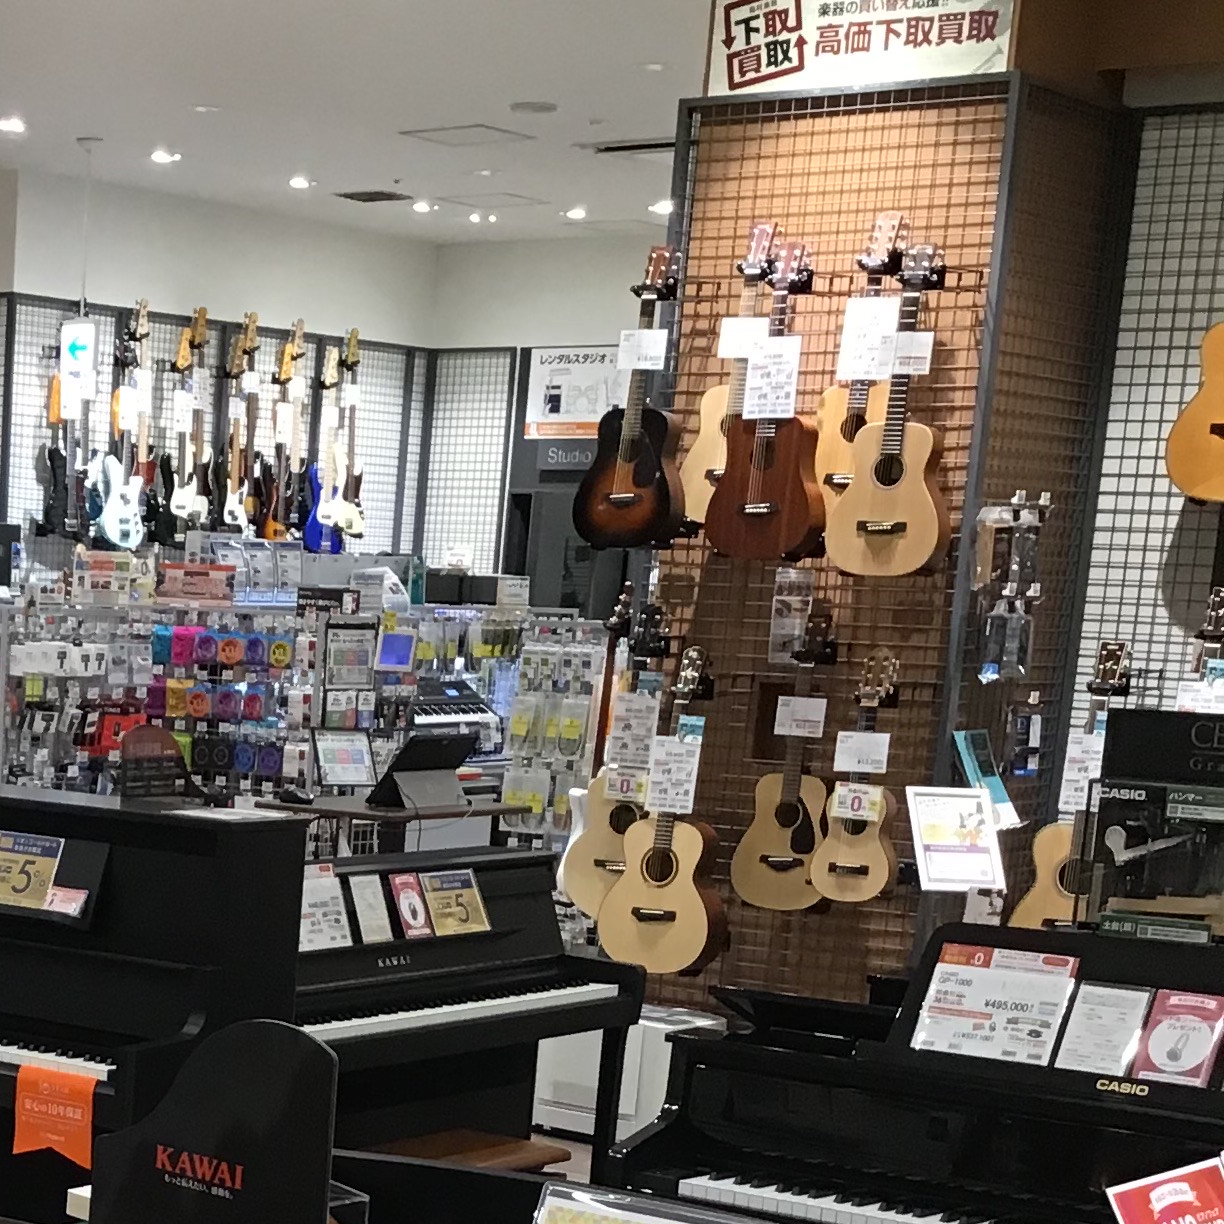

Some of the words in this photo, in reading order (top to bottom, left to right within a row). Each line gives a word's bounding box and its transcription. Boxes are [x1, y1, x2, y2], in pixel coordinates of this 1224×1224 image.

[734, 7, 792, 45] 下取
[814, 10, 1000, 57] 高価下取買取
[737, 38, 793, 78] 買取
[539, 352, 607, 366] レンタルスタジオ
[547, 447, 592, 463] Studio
[1098, 787, 1148, 801] CASIO
[1168, 791, 1203, 801] ハンマー
[984, 997, 1030, 1014] ¥495,000
[1095, 1079, 1150, 1097] CASIO
[155, 1144, 246, 1191] KAWAI
